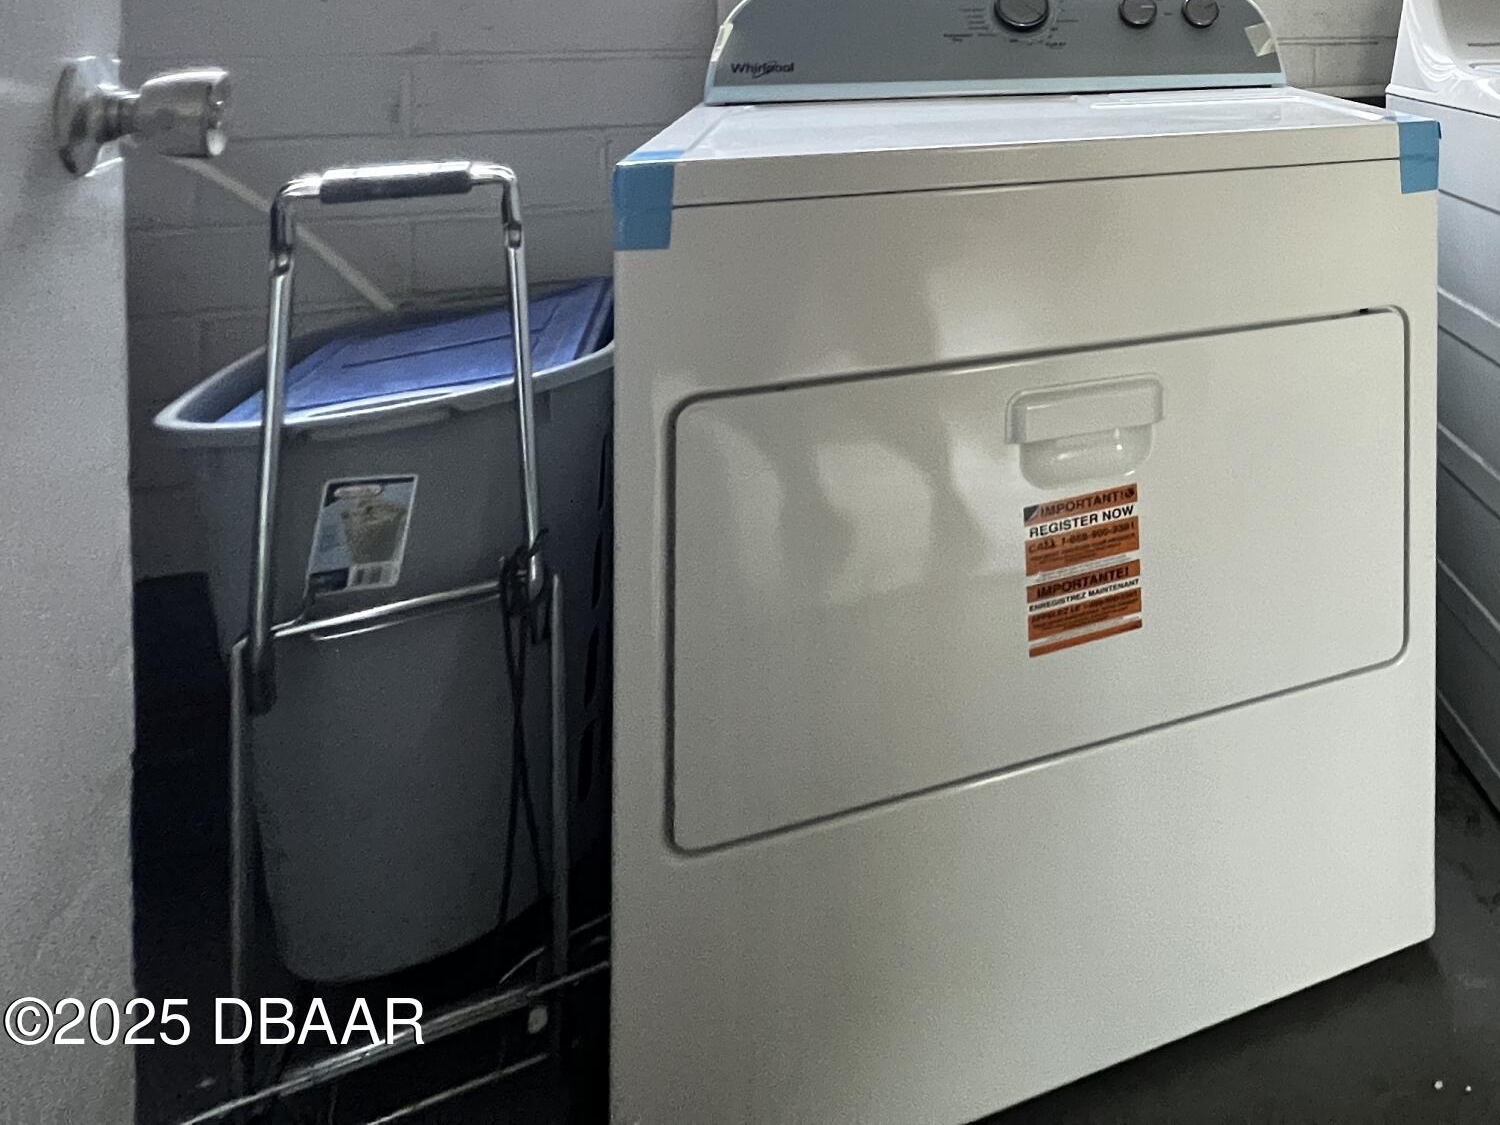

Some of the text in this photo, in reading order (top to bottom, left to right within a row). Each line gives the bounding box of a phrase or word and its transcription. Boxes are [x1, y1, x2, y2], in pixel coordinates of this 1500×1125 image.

[730, 60, 795, 80] Whirlpool
[1029, 504, 1135, 539] REGISTER NOW
[1028, 538, 1057, 554] CALL
[1028, 592, 1087, 612] ENREGISTREZ
[1088, 578, 1140, 597] MAINTENANT
[1036, 566, 1129, 599] IMPORTANTE!
